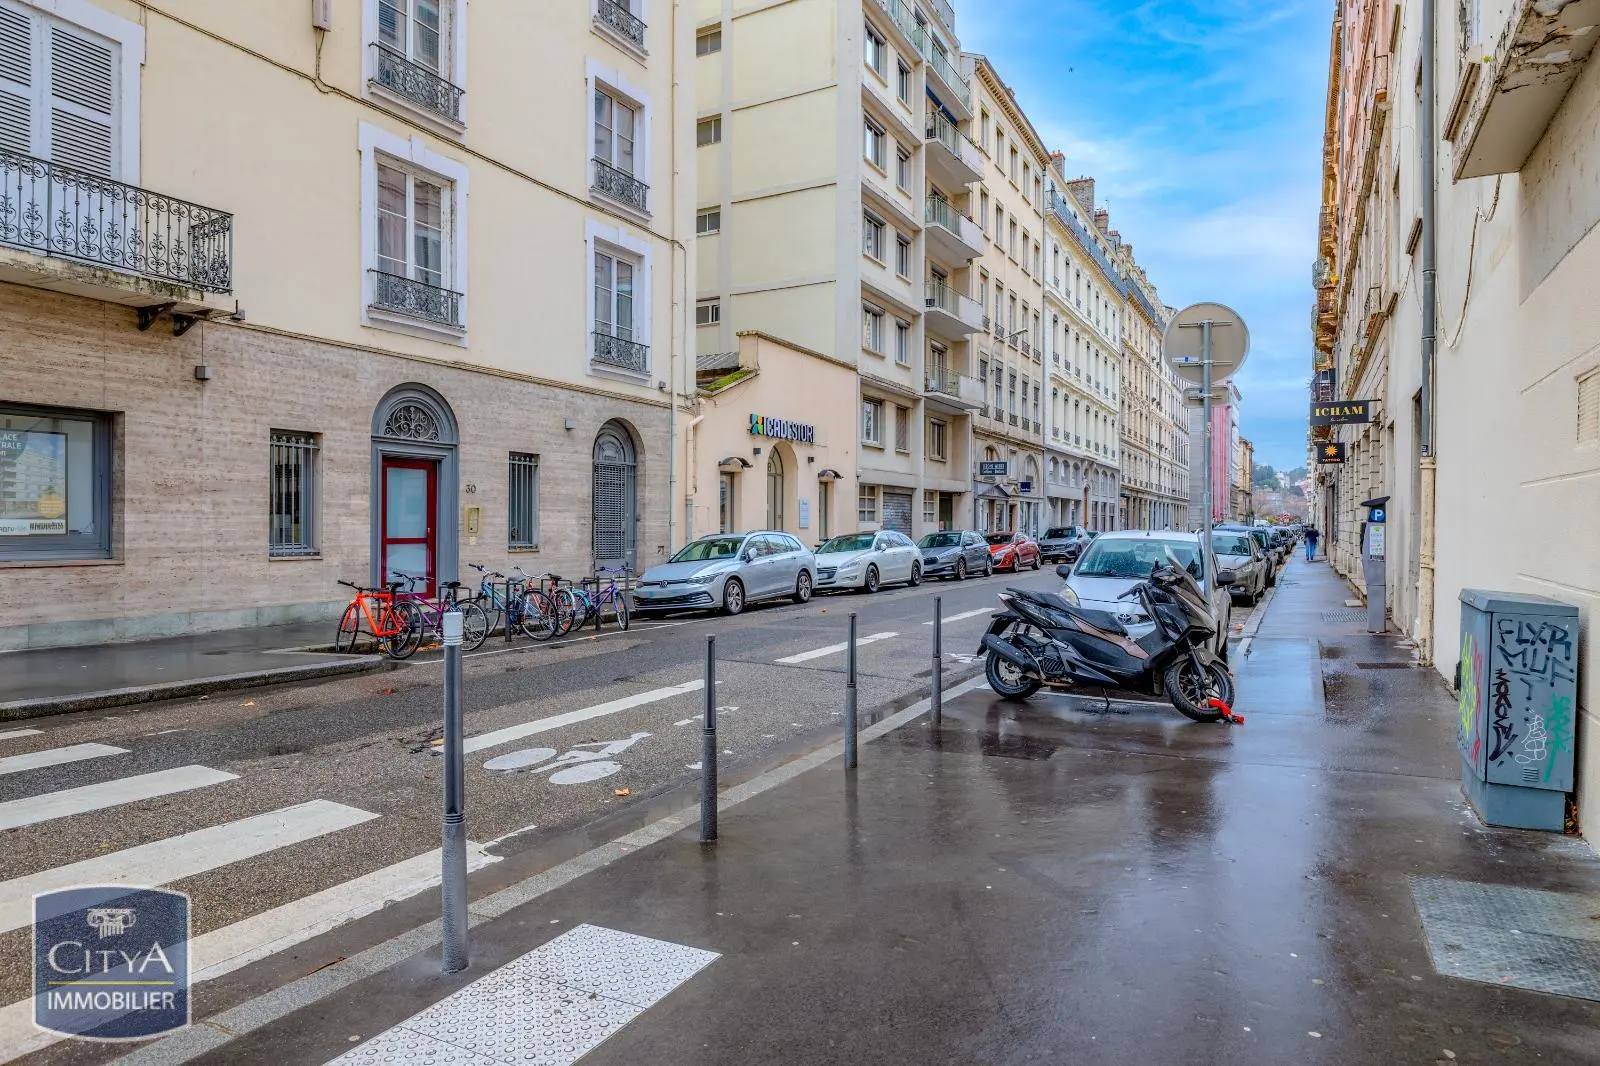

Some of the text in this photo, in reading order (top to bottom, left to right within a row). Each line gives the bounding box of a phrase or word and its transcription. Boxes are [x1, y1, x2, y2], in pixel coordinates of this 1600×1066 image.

[1314, 405, 1363, 416] ICHAM
[465, 484, 477, 494] 30
[1374, 509, 1384, 521] P
